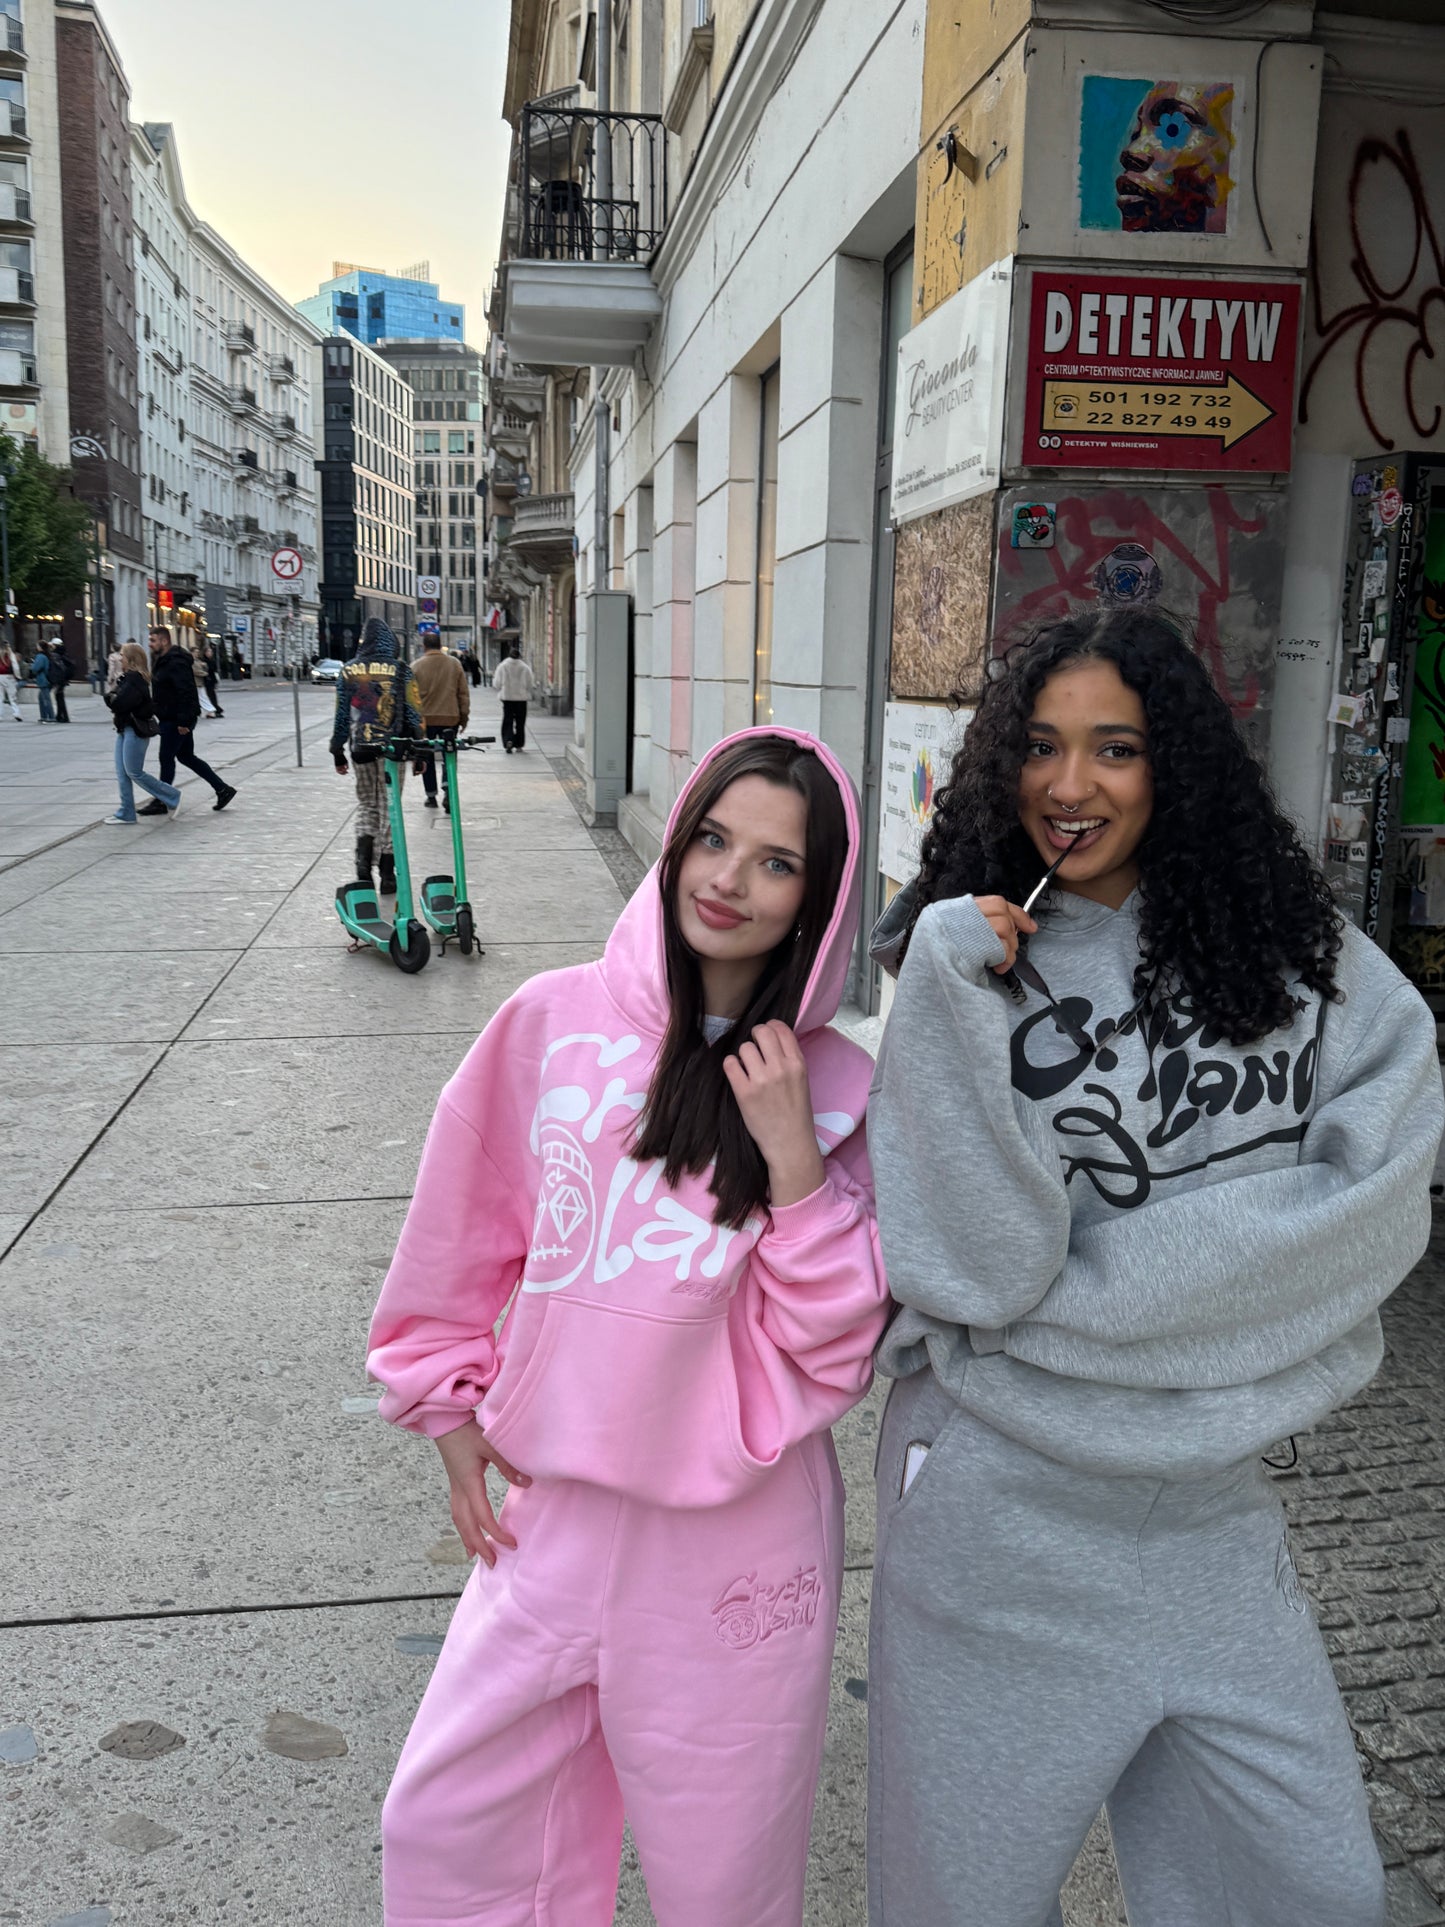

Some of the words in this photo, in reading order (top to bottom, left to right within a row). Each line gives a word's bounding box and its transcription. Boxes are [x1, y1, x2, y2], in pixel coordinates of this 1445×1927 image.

[1043, 291, 1283, 362] DETEKTYW
[1044, 364, 1079, 376] CENTRUM
[1152, 368, 1195, 381] INFORMACJI
[1195, 370, 1224, 382] JAWNEJ
[905, 334, 977, 437] Gioconda
[946, 378, 975, 412] CENTER
[1088, 391, 1129, 405] 501
[1140, 392, 1181, 406] 192
[1191, 394, 1232, 408] 732
[1086, 412, 1114, 425] 22
[1121, 413, 1162, 427] 827
[1169, 415, 1197, 428] 49
[1204, 416, 1232, 429] 49
[1065, 440, 1108, 448] DETEKTYW
[1111, 440, 1159, 449] WIŚNIEWSKI
